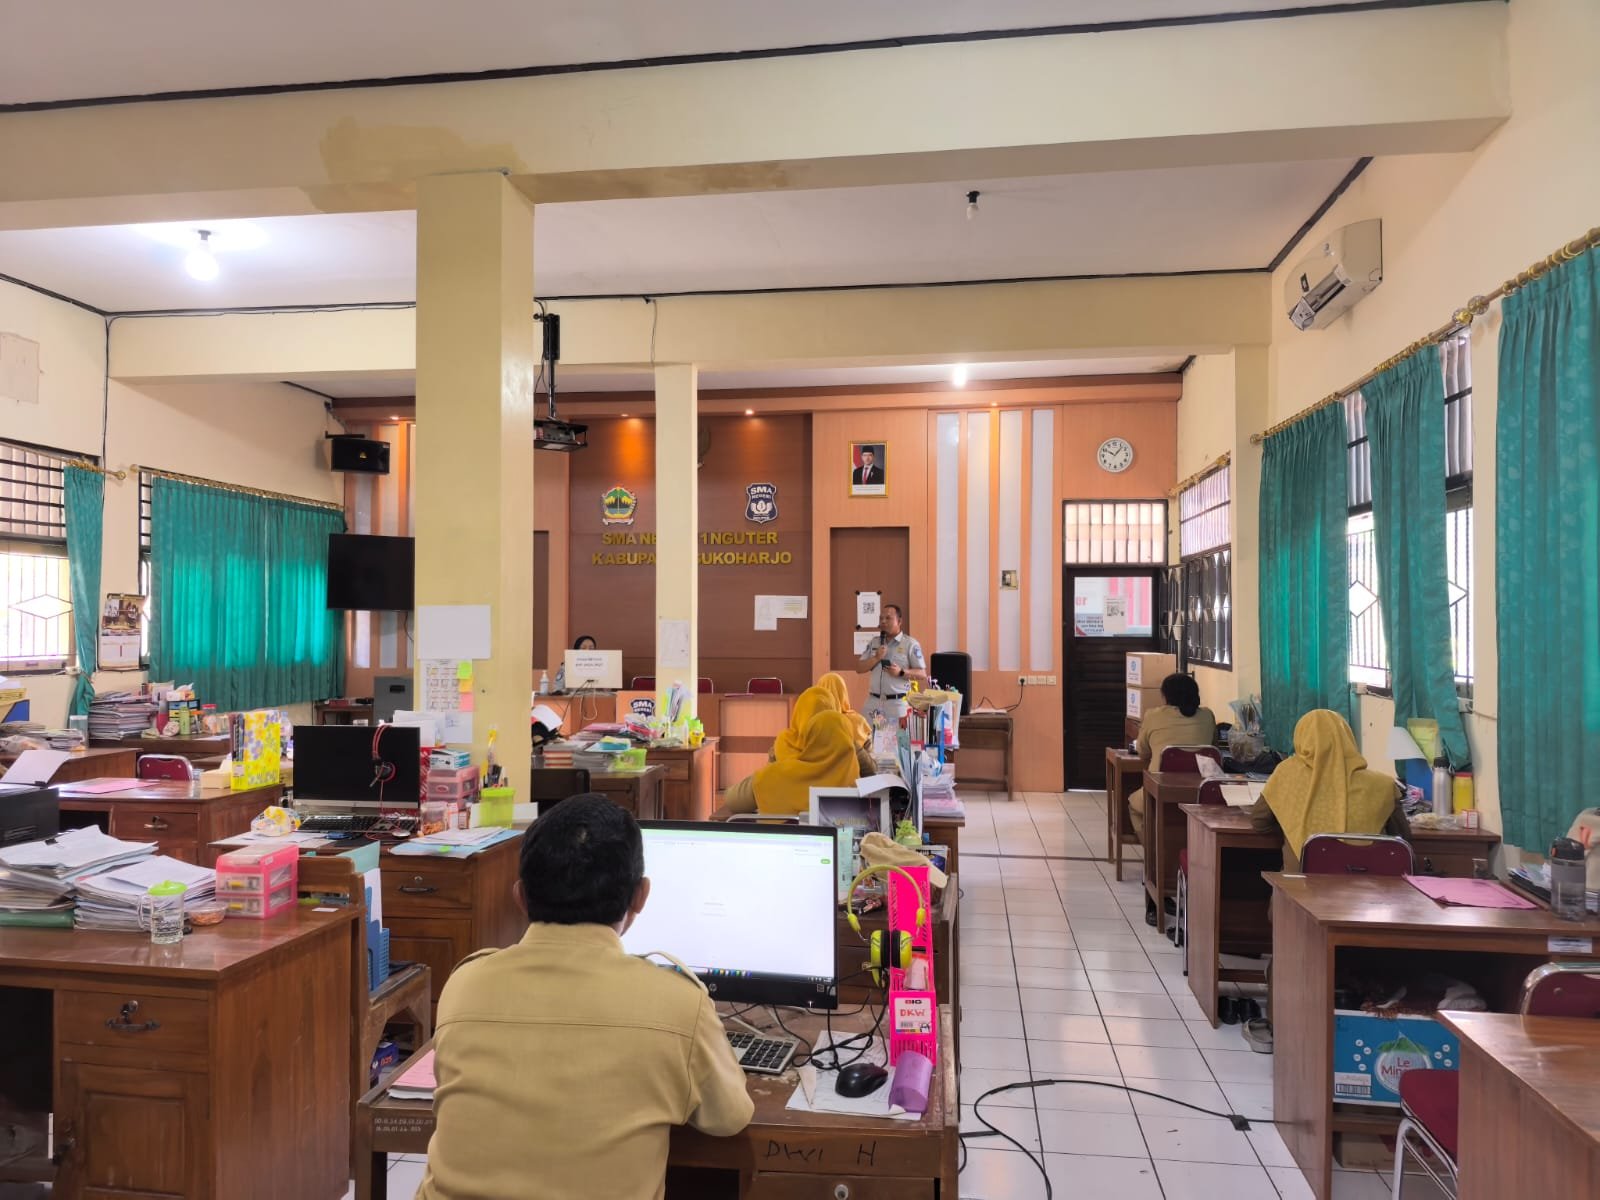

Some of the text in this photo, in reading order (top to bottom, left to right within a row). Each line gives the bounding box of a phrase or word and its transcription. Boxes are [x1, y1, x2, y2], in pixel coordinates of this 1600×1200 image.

[750, 486, 773, 495] SMA
[602, 533, 637, 545] SMA
[710, 531, 778, 545] NGUTER
[592, 552, 657, 566] KABUPA
[900, 1008, 926, 1017] DKW
[1397, 1057, 1410, 1068] Le
[857, 1140, 878, 1167] H
